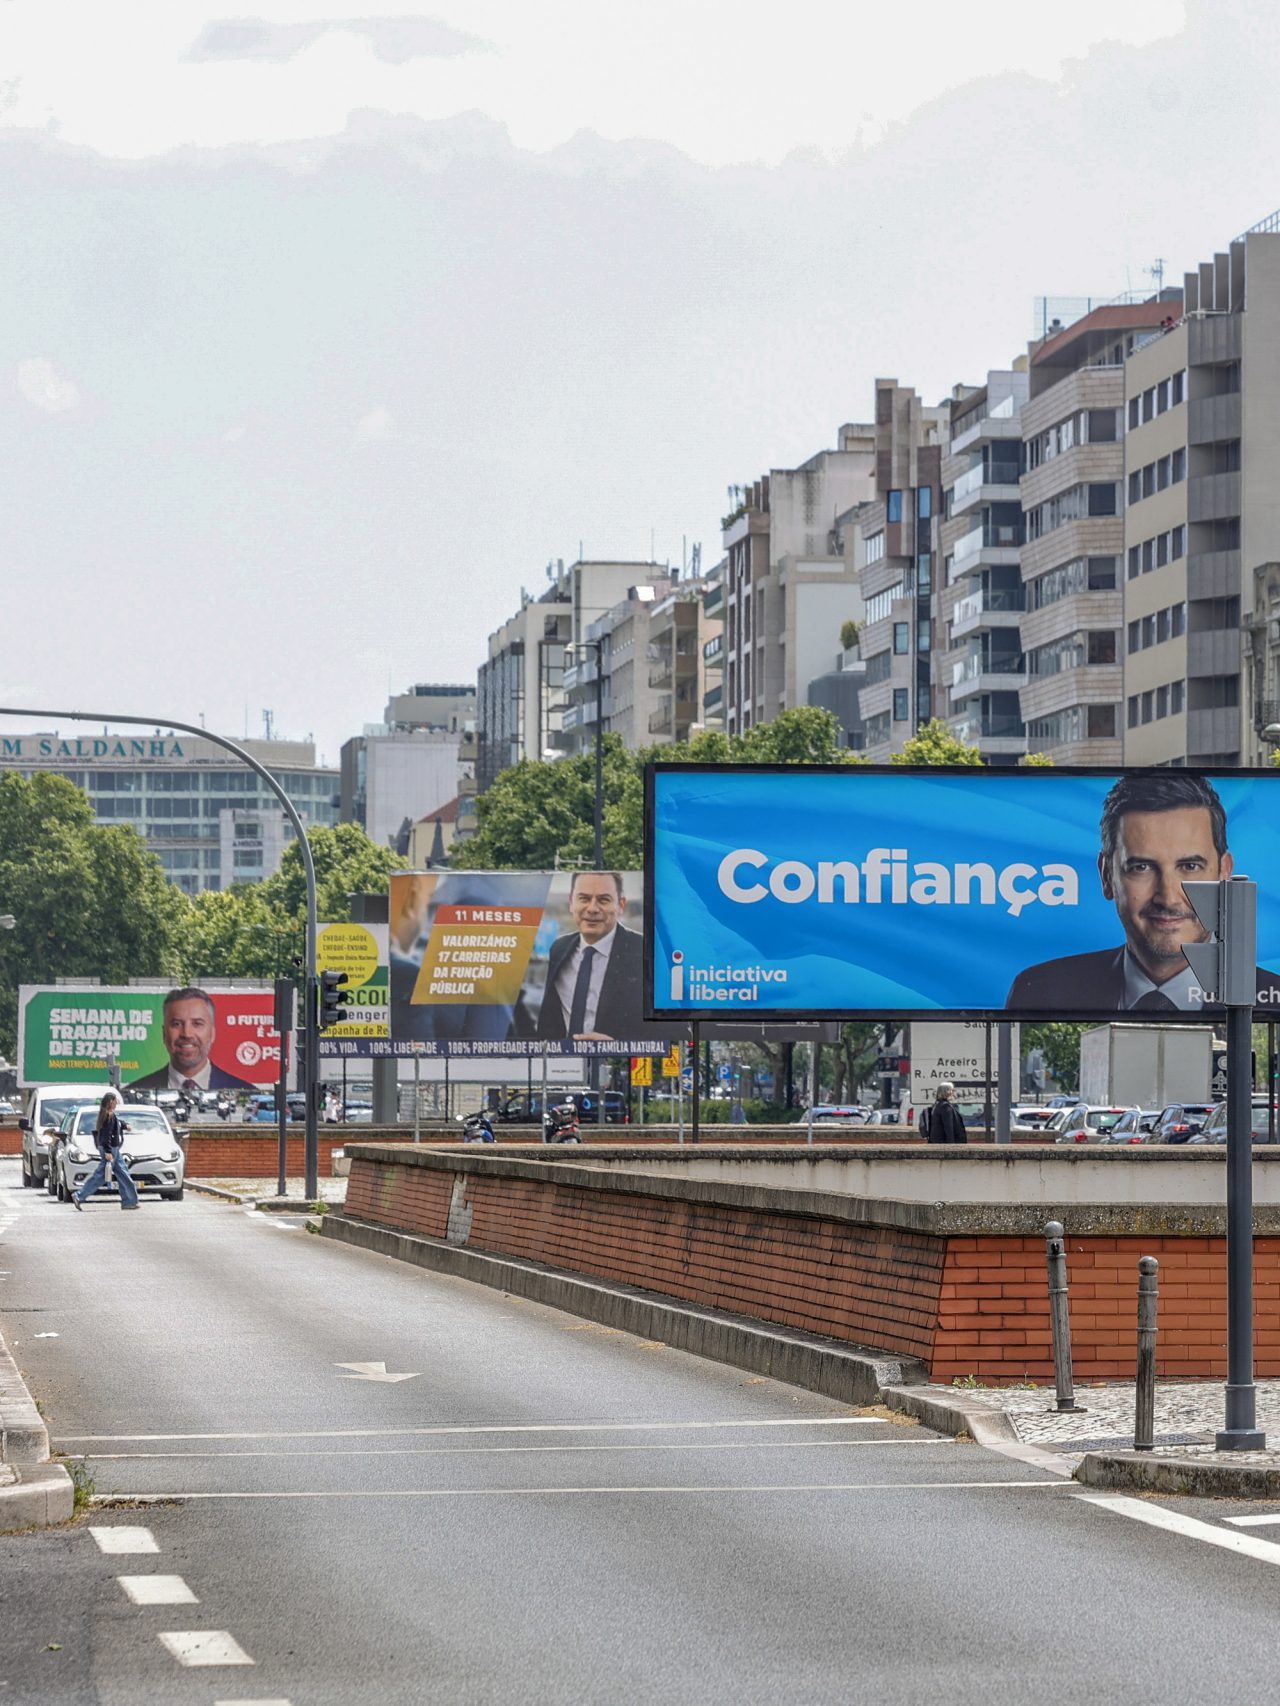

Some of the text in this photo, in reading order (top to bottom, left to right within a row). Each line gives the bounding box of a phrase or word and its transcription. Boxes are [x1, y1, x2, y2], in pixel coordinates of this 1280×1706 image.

[39, 738, 185, 758] SALDANHA
[717, 847, 1079, 917] Confiança
[455, 910, 522, 922] 11 MESES
[442, 934, 517, 948] VALORIZÁMOS
[438, 951, 511, 963] 17 CARREIRAS
[433, 965, 493, 981] DA FUNÇÃO
[689, 965, 787, 983] iniciativa
[429, 981, 475, 994] PÚBLICA
[689, 984, 758, 1001] liberal
[1187, 986, 1215, 1003] Ru
[49, 1008, 153, 1025] SEMANA DE
[226, 1014, 236, 1025] O
[49, 1025, 148, 1041] TRABALHO
[363, 1025, 373, 1035] de
[49, 1041, 121, 1058] DE 37,5H
[262, 1046, 281, 1060] PS
[339, 1042, 358, 1053] VIDA
[369, 1042, 392, 1054] 100%
[448, 1042, 470, 1054] 100%
[472, 1042, 527, 1054] PROPRIEDADE
[573, 1042, 596, 1053] 100%
[597, 1041, 629, 1053] FAMÍLIA
[630, 1041, 666, 1053] NATURAL
[937, 1057, 977, 1067] Areeiro
[914, 1069, 926, 1079] R.
[930, 1069, 956, 1078] Arco
[971, 1069, 1000, 1078] Ceo
